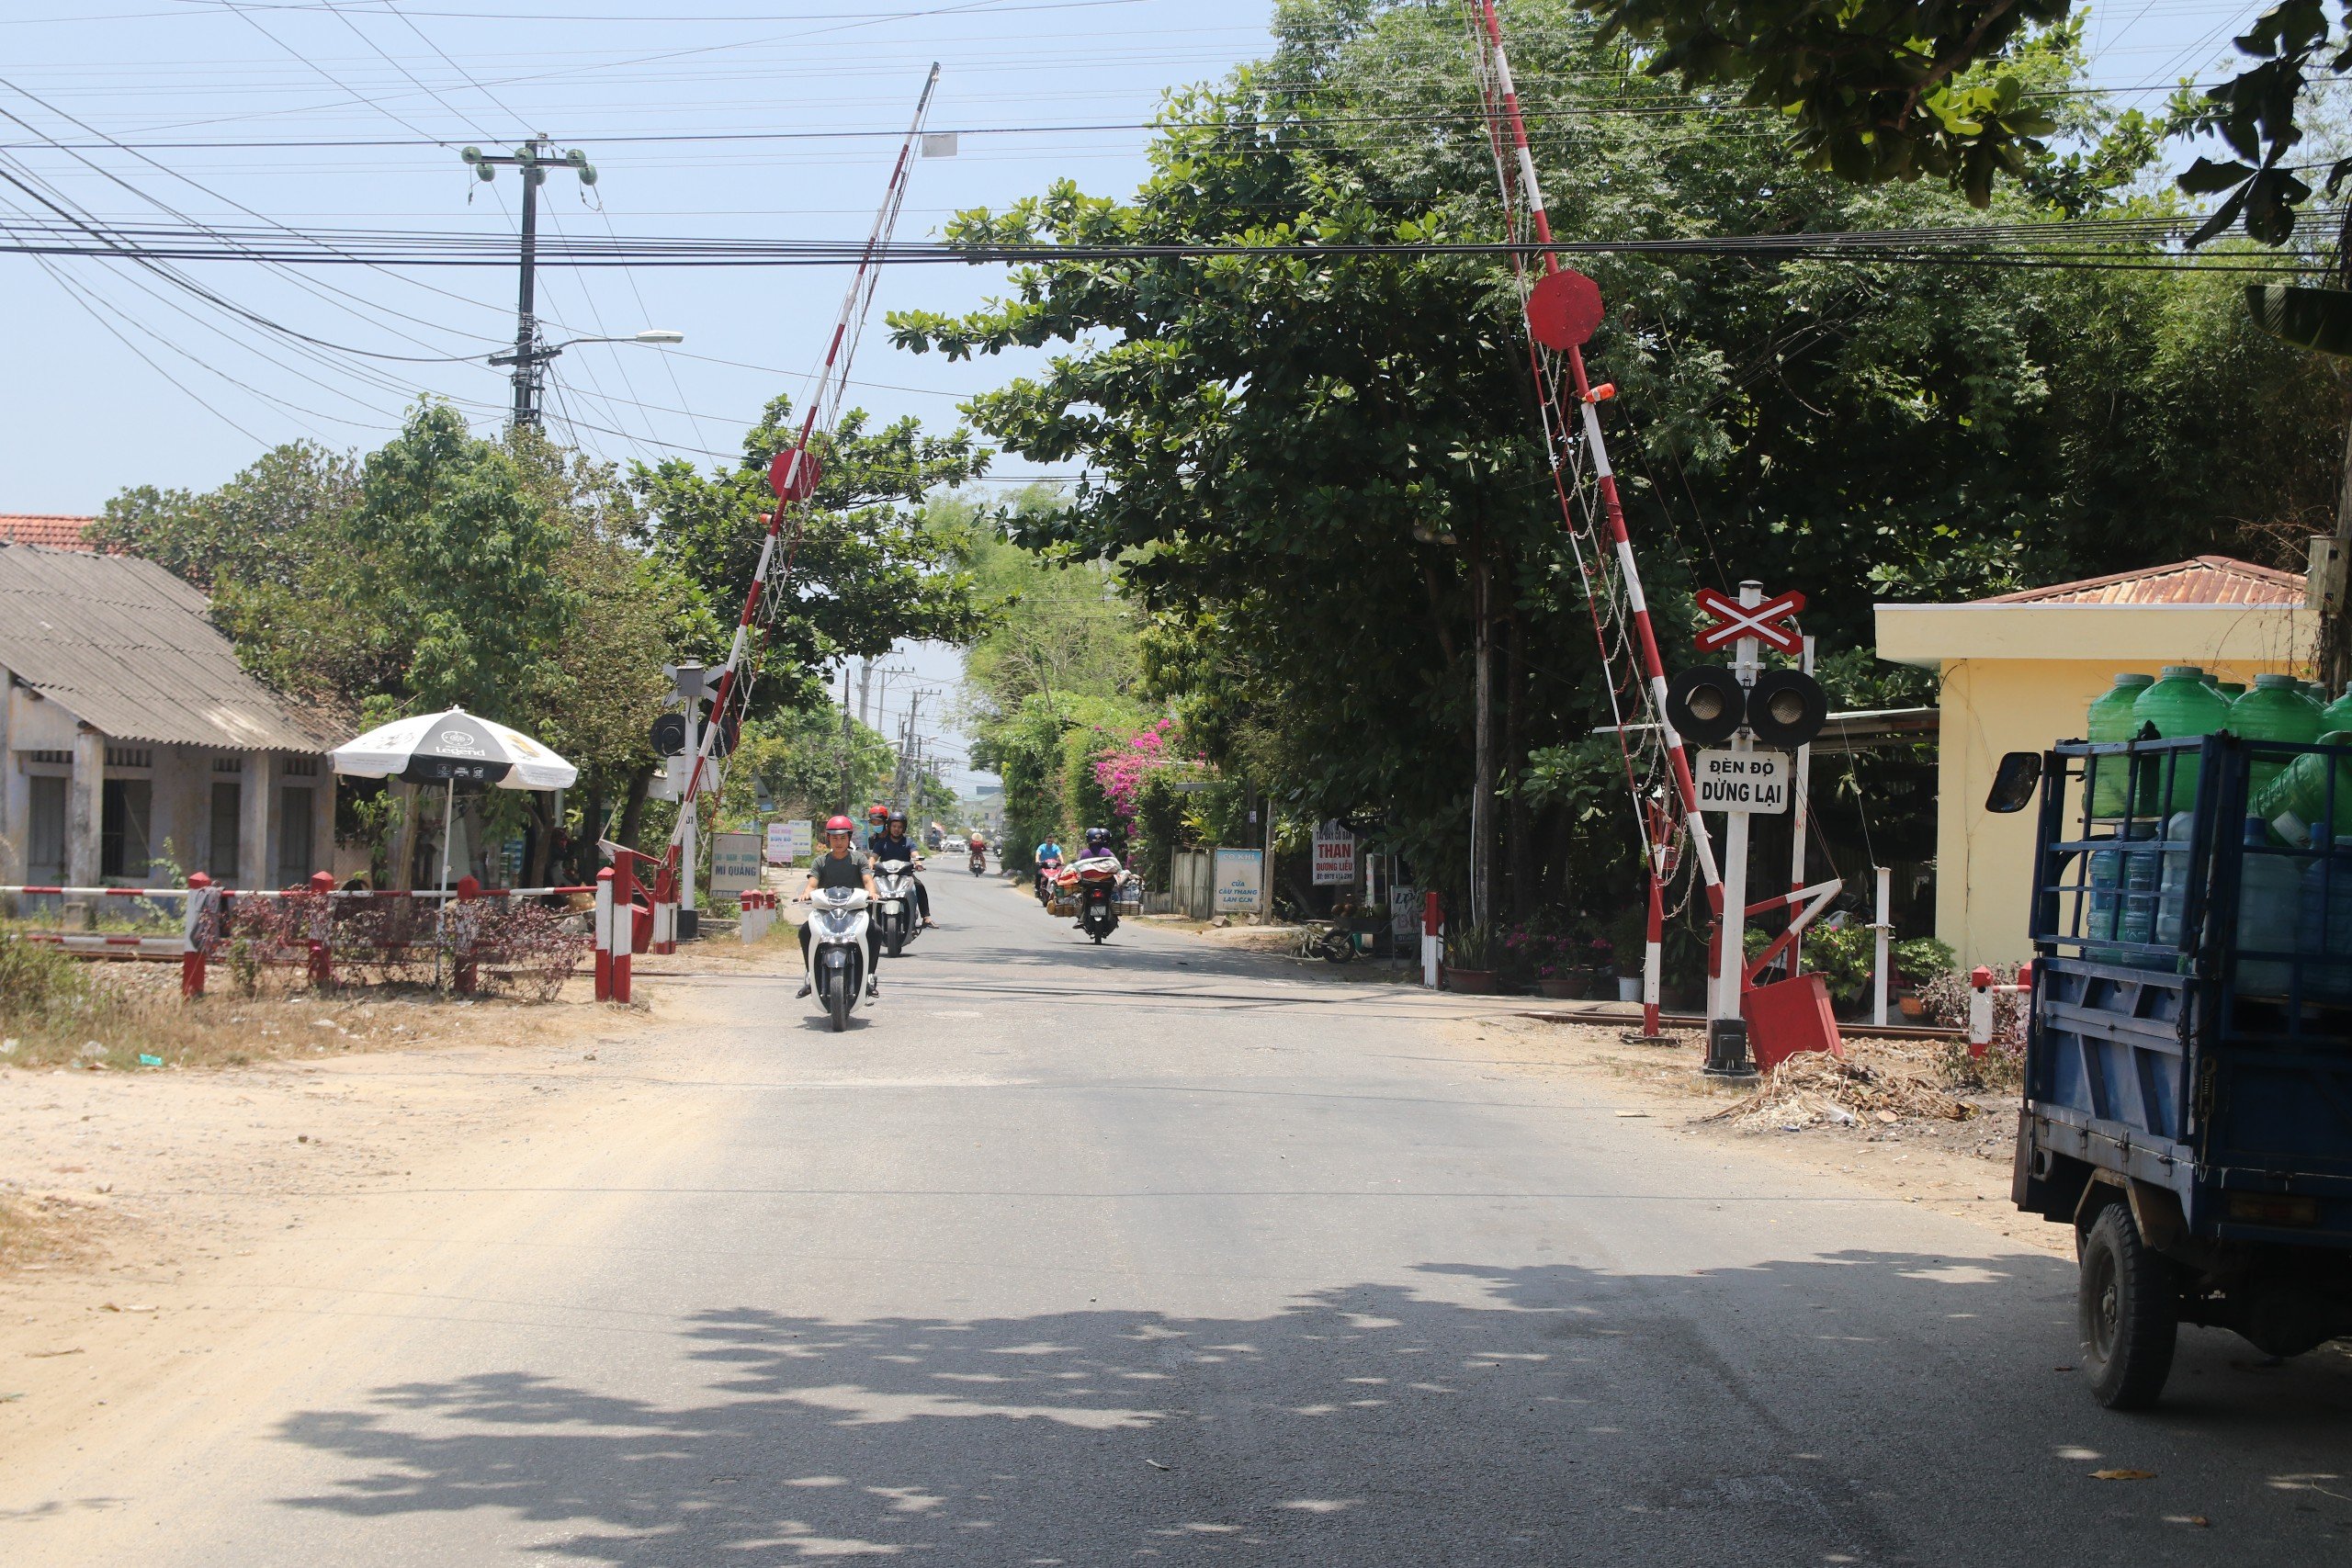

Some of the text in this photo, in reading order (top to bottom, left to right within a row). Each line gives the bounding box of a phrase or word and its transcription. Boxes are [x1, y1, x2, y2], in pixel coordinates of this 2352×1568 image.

[435, 746, 486, 757] Legend
[1709, 758, 1774, 775] ĐÈN ĐỎ
[1702, 778, 1781, 807] DỪNG LẠI
[1317, 843, 1351, 858] THAN
[728, 863, 757, 877] QUẢNG
